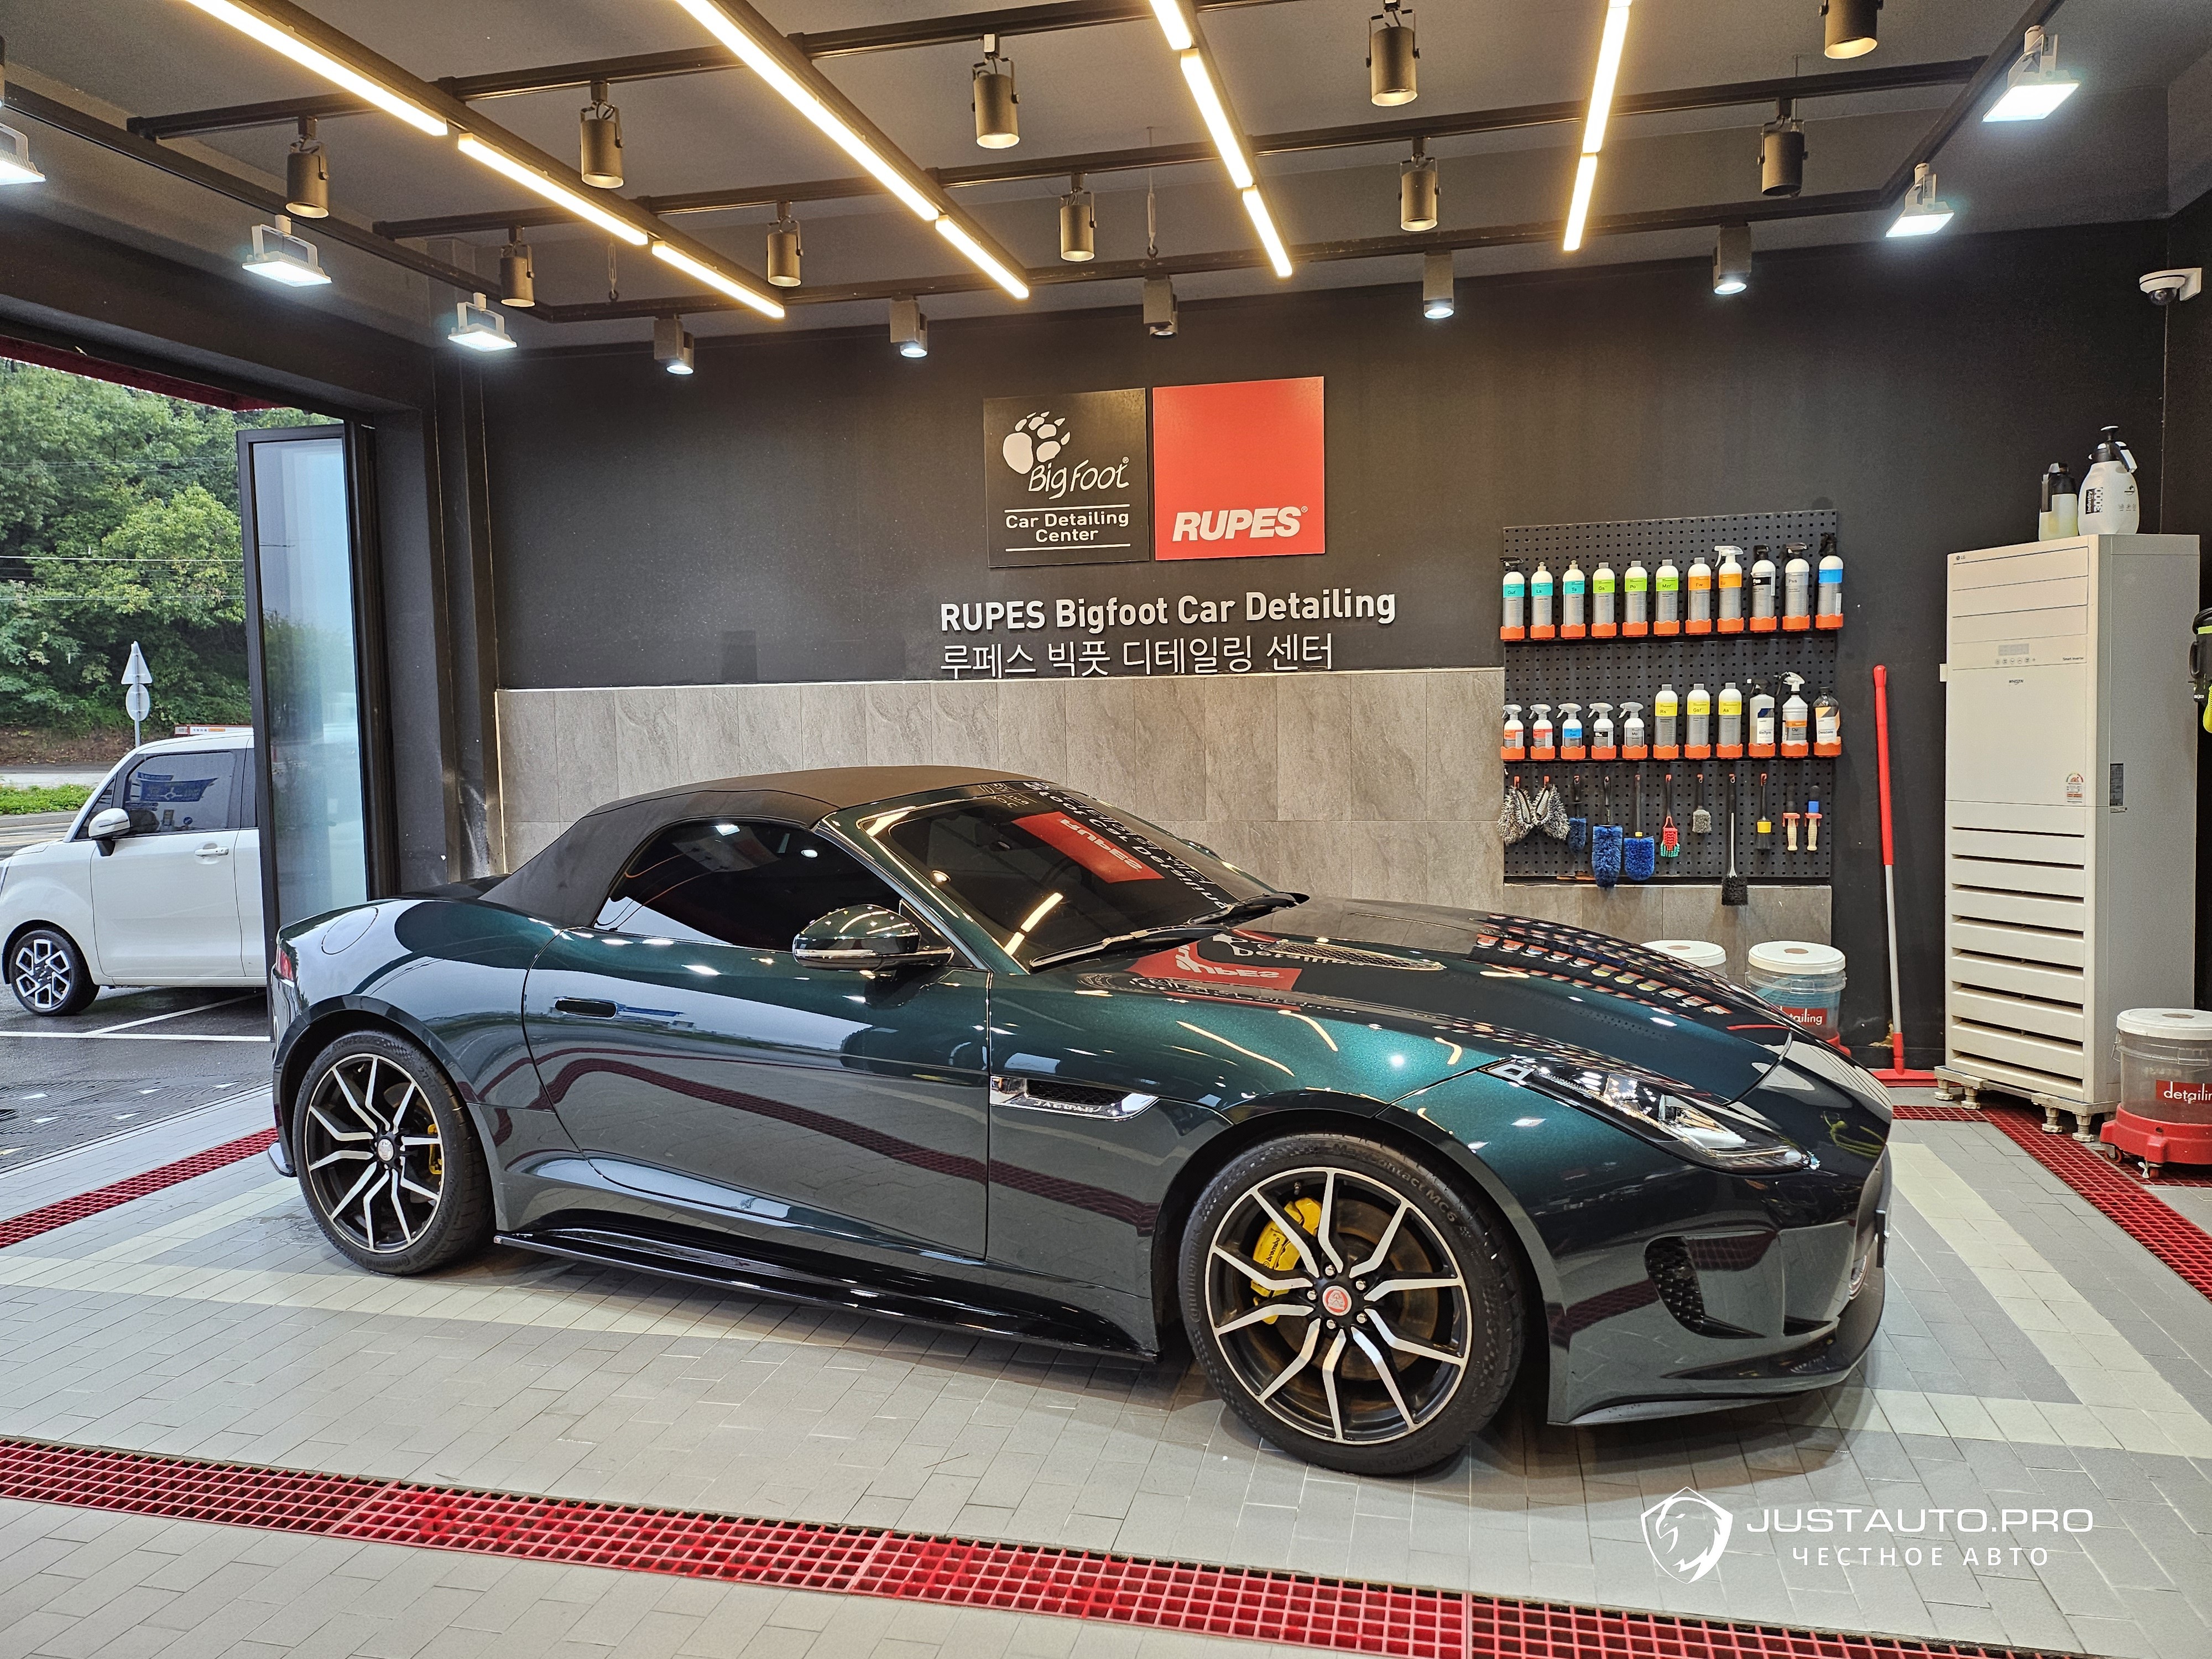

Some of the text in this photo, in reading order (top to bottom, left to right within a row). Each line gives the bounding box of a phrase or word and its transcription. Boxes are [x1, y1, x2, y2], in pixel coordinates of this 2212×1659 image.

[2094, 487, 2103, 513] 3000
[1006, 512, 1129, 529] Car Detailing
[1172, 507, 1302, 541] RUPES
[1035, 526, 1098, 543] Center
[941, 588, 1396, 634] RUPES Bigfoot Car Detailing
[941, 633, 1332, 680] 루페스 빅풋 디테일링 센터
[1033, 1100, 1102, 1113] JAGUAR
[1266, 1237, 1280, 1262] brembo
